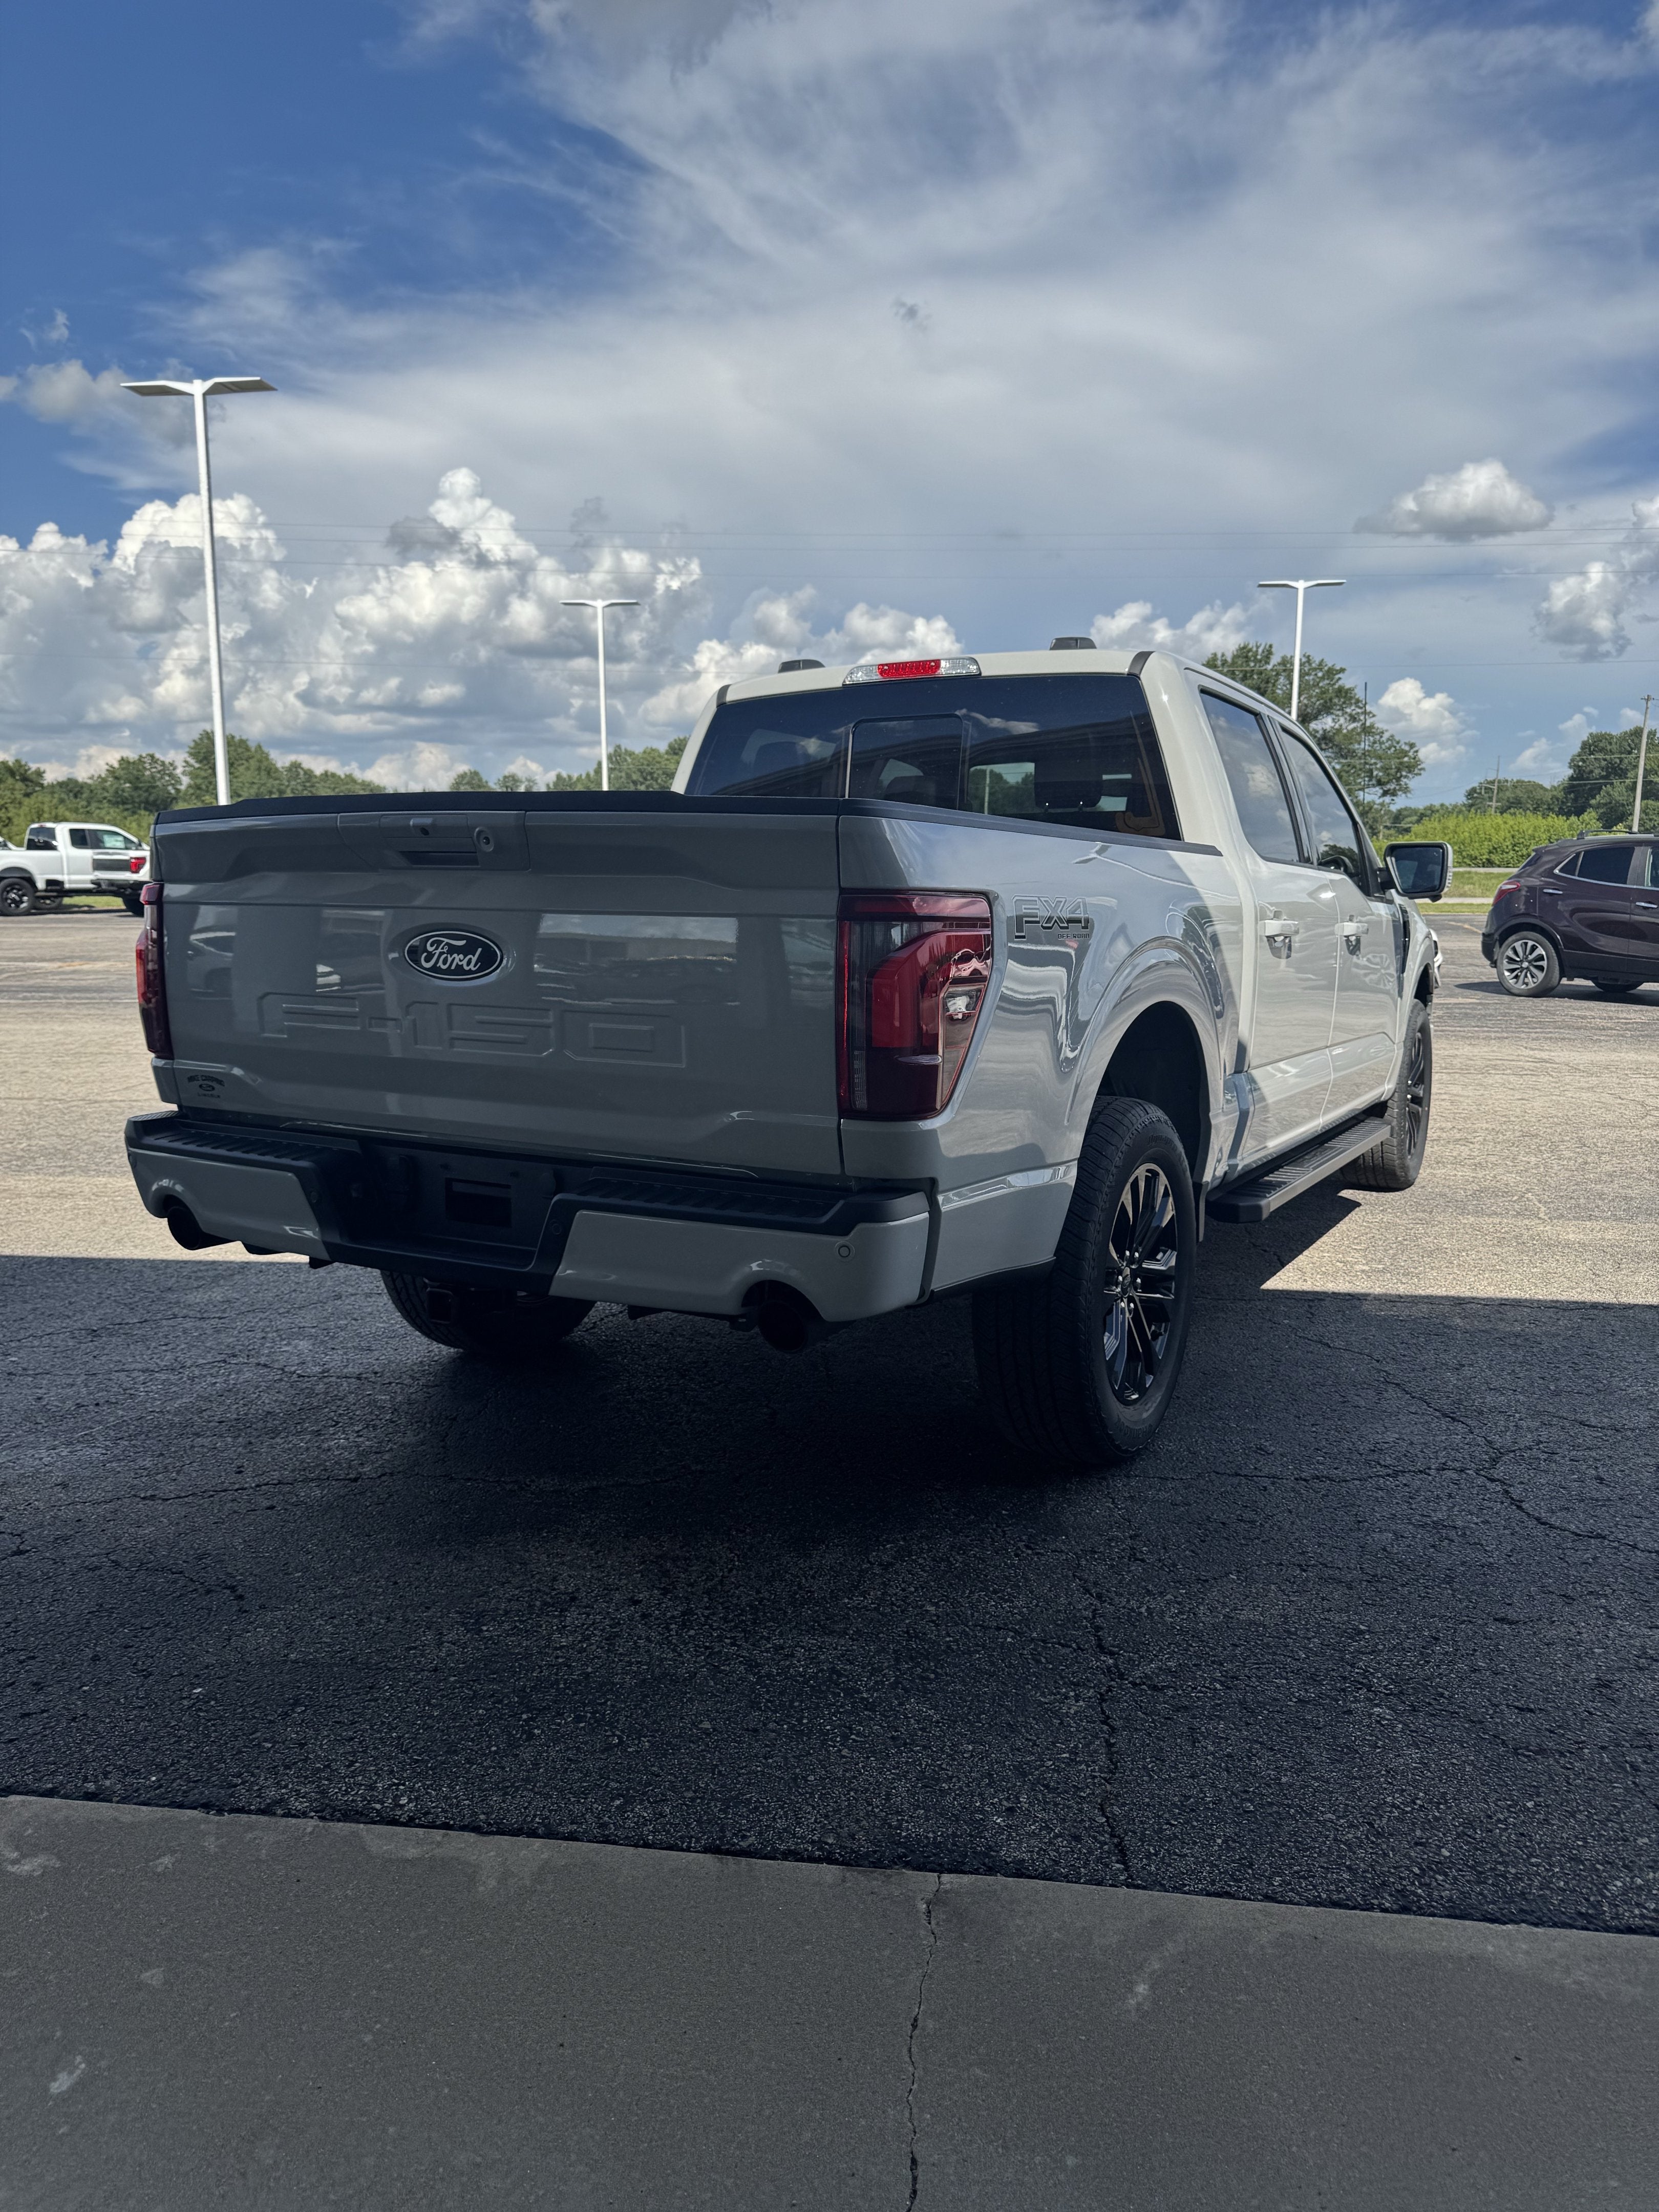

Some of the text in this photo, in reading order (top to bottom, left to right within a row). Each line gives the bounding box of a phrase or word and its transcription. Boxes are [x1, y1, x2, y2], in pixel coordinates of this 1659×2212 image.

[1012, 895, 1090, 940] FX4
[421, 937, 482, 971] Ford
[257, 991, 686, 1068] F-150
